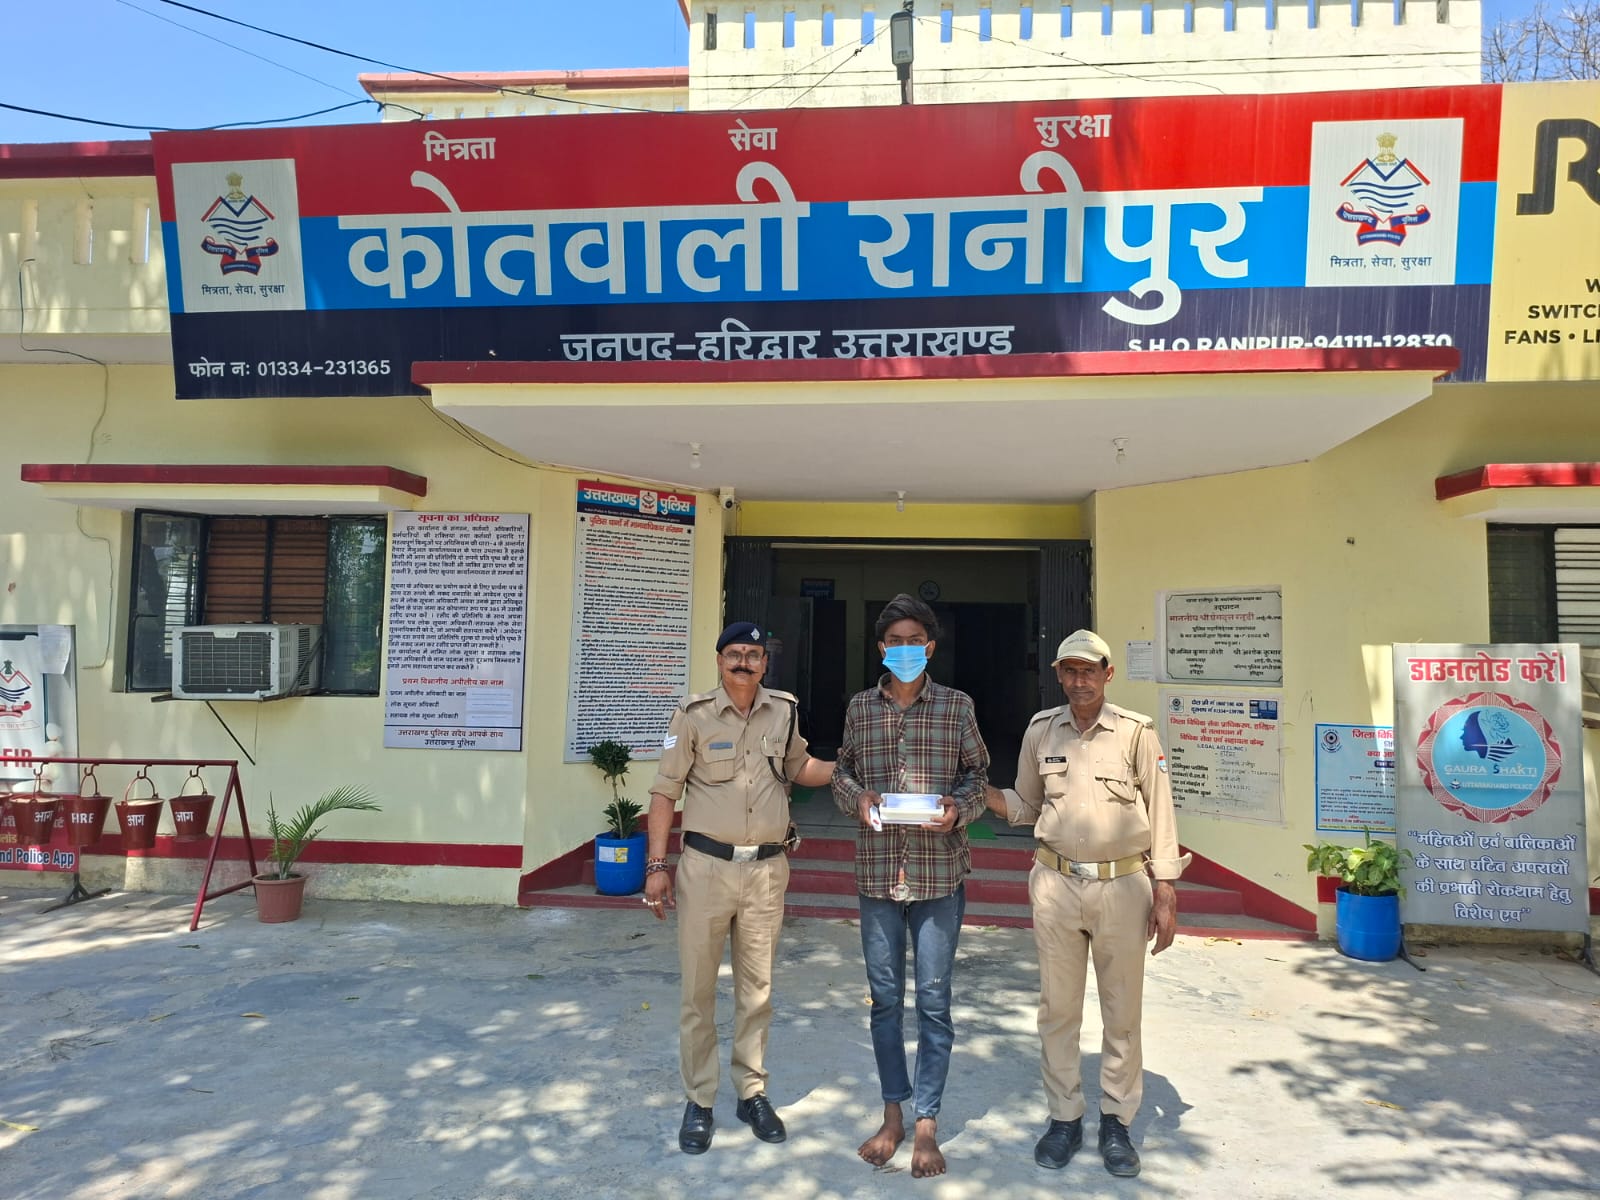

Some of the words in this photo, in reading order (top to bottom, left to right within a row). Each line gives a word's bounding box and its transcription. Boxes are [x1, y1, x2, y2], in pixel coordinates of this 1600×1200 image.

[729, 119, 778, 151] सेवा
[1034, 114, 1112, 148] सुरक्षा
[423, 131, 497, 162] मित्रता
[337, 161, 811, 300] कोतवाली
[848, 150, 1263, 325] रानीपुर
[1330, 256, 1367, 269] मित्रता,
[1371, 254, 1397, 269] सेवा,
[1401, 256, 1433, 272] सुरक्षा
[202, 284, 232, 296] मित्रता,
[235, 282, 257, 295] सेवा,
[259, 284, 286, 298] सुरक्षा
[832, 325, 1015, 358] उत्तराखण्ड
[1505, 330, 1560, 344] FANS
[189, 357, 225, 377] फोन
[258, 359, 391, 377] 01334-231365
[583, 488, 639, 507] उत्तराखण्ड
[659, 495, 692, 516] पुलिस
[417, 514, 445, 524] सूचना
[463, 513, 500, 523] अधिकार
[1408, 651, 1511, 683] डाउनलोड
[430, 728, 449, 739] पुलिस
[456, 737, 476, 748] पुलिस
[1352, 728, 1375, 739] जिला
[1443, 765, 1488, 775] GAURA
[126, 813, 146, 826] आग
[175, 811, 194, 824] आग
[1478, 832, 1500, 850] एवं
[1504, 833, 1576, 853] बालिकाओं
[16, 848, 50, 867] Police
[53, 850, 75, 869] App
[1415, 853, 1432, 870] के
[1434, 857, 1466, 872] साथ
[1470, 856, 1507, 874] घटित
[1511, 858, 1569, 876] अपराधों
[1415, 879, 1434, 894] की
[1438, 879, 1482, 897] प्रभावी
[1486, 880, 1544, 899] रोकथाम
[1547, 883, 1572, 905] हेतु
[1453, 902, 1494, 922] विशेष
